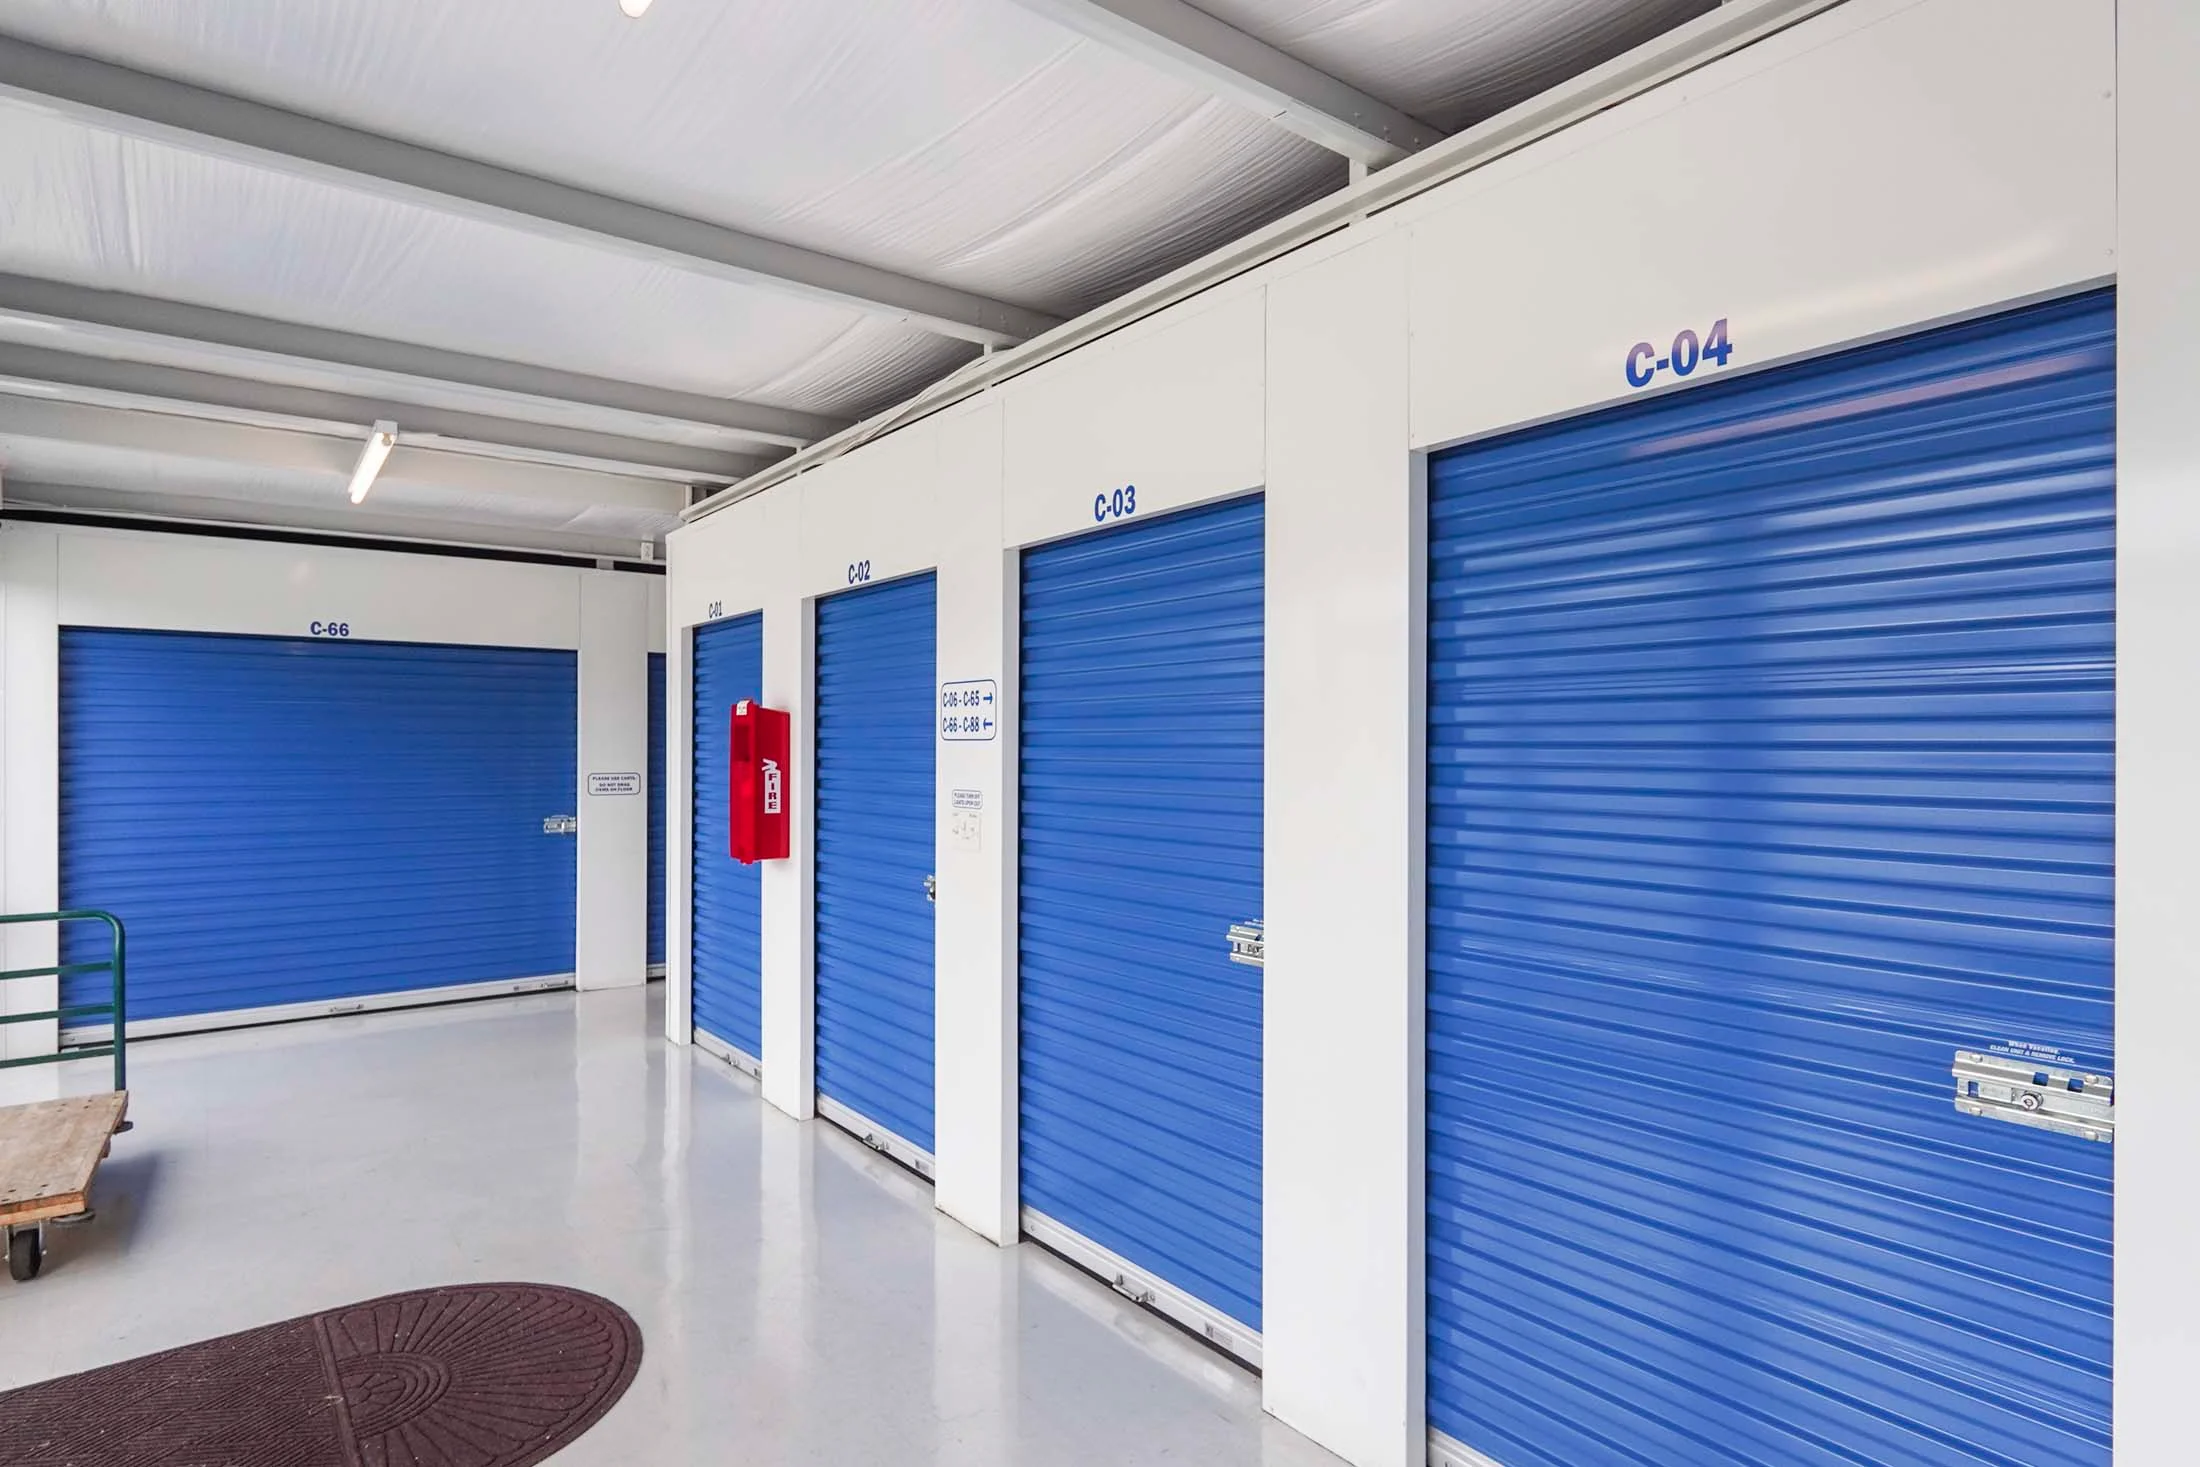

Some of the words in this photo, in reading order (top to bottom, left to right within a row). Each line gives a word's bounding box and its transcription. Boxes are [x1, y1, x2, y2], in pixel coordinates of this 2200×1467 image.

[1626, 318, 1733, 388] C-04
[1095, 485, 1136, 522] C-03
[848, 559, 870, 584] C-02
[708, 599, 722, 619] C-01
[310, 620, 350, 637] C-66
[943, 691, 957, 707] C-06
[963, 690, 980, 707] C-65
[943, 717, 957, 732] C-66
[963, 716, 980, 732] C-88
[768, 773, 777, 810] FIRE
[1990, 1044, 2010, 1053] CLEAN
[2010, 1047, 2025, 1056] UNIT
[2031, 1051, 2057, 1060] REMOVE
